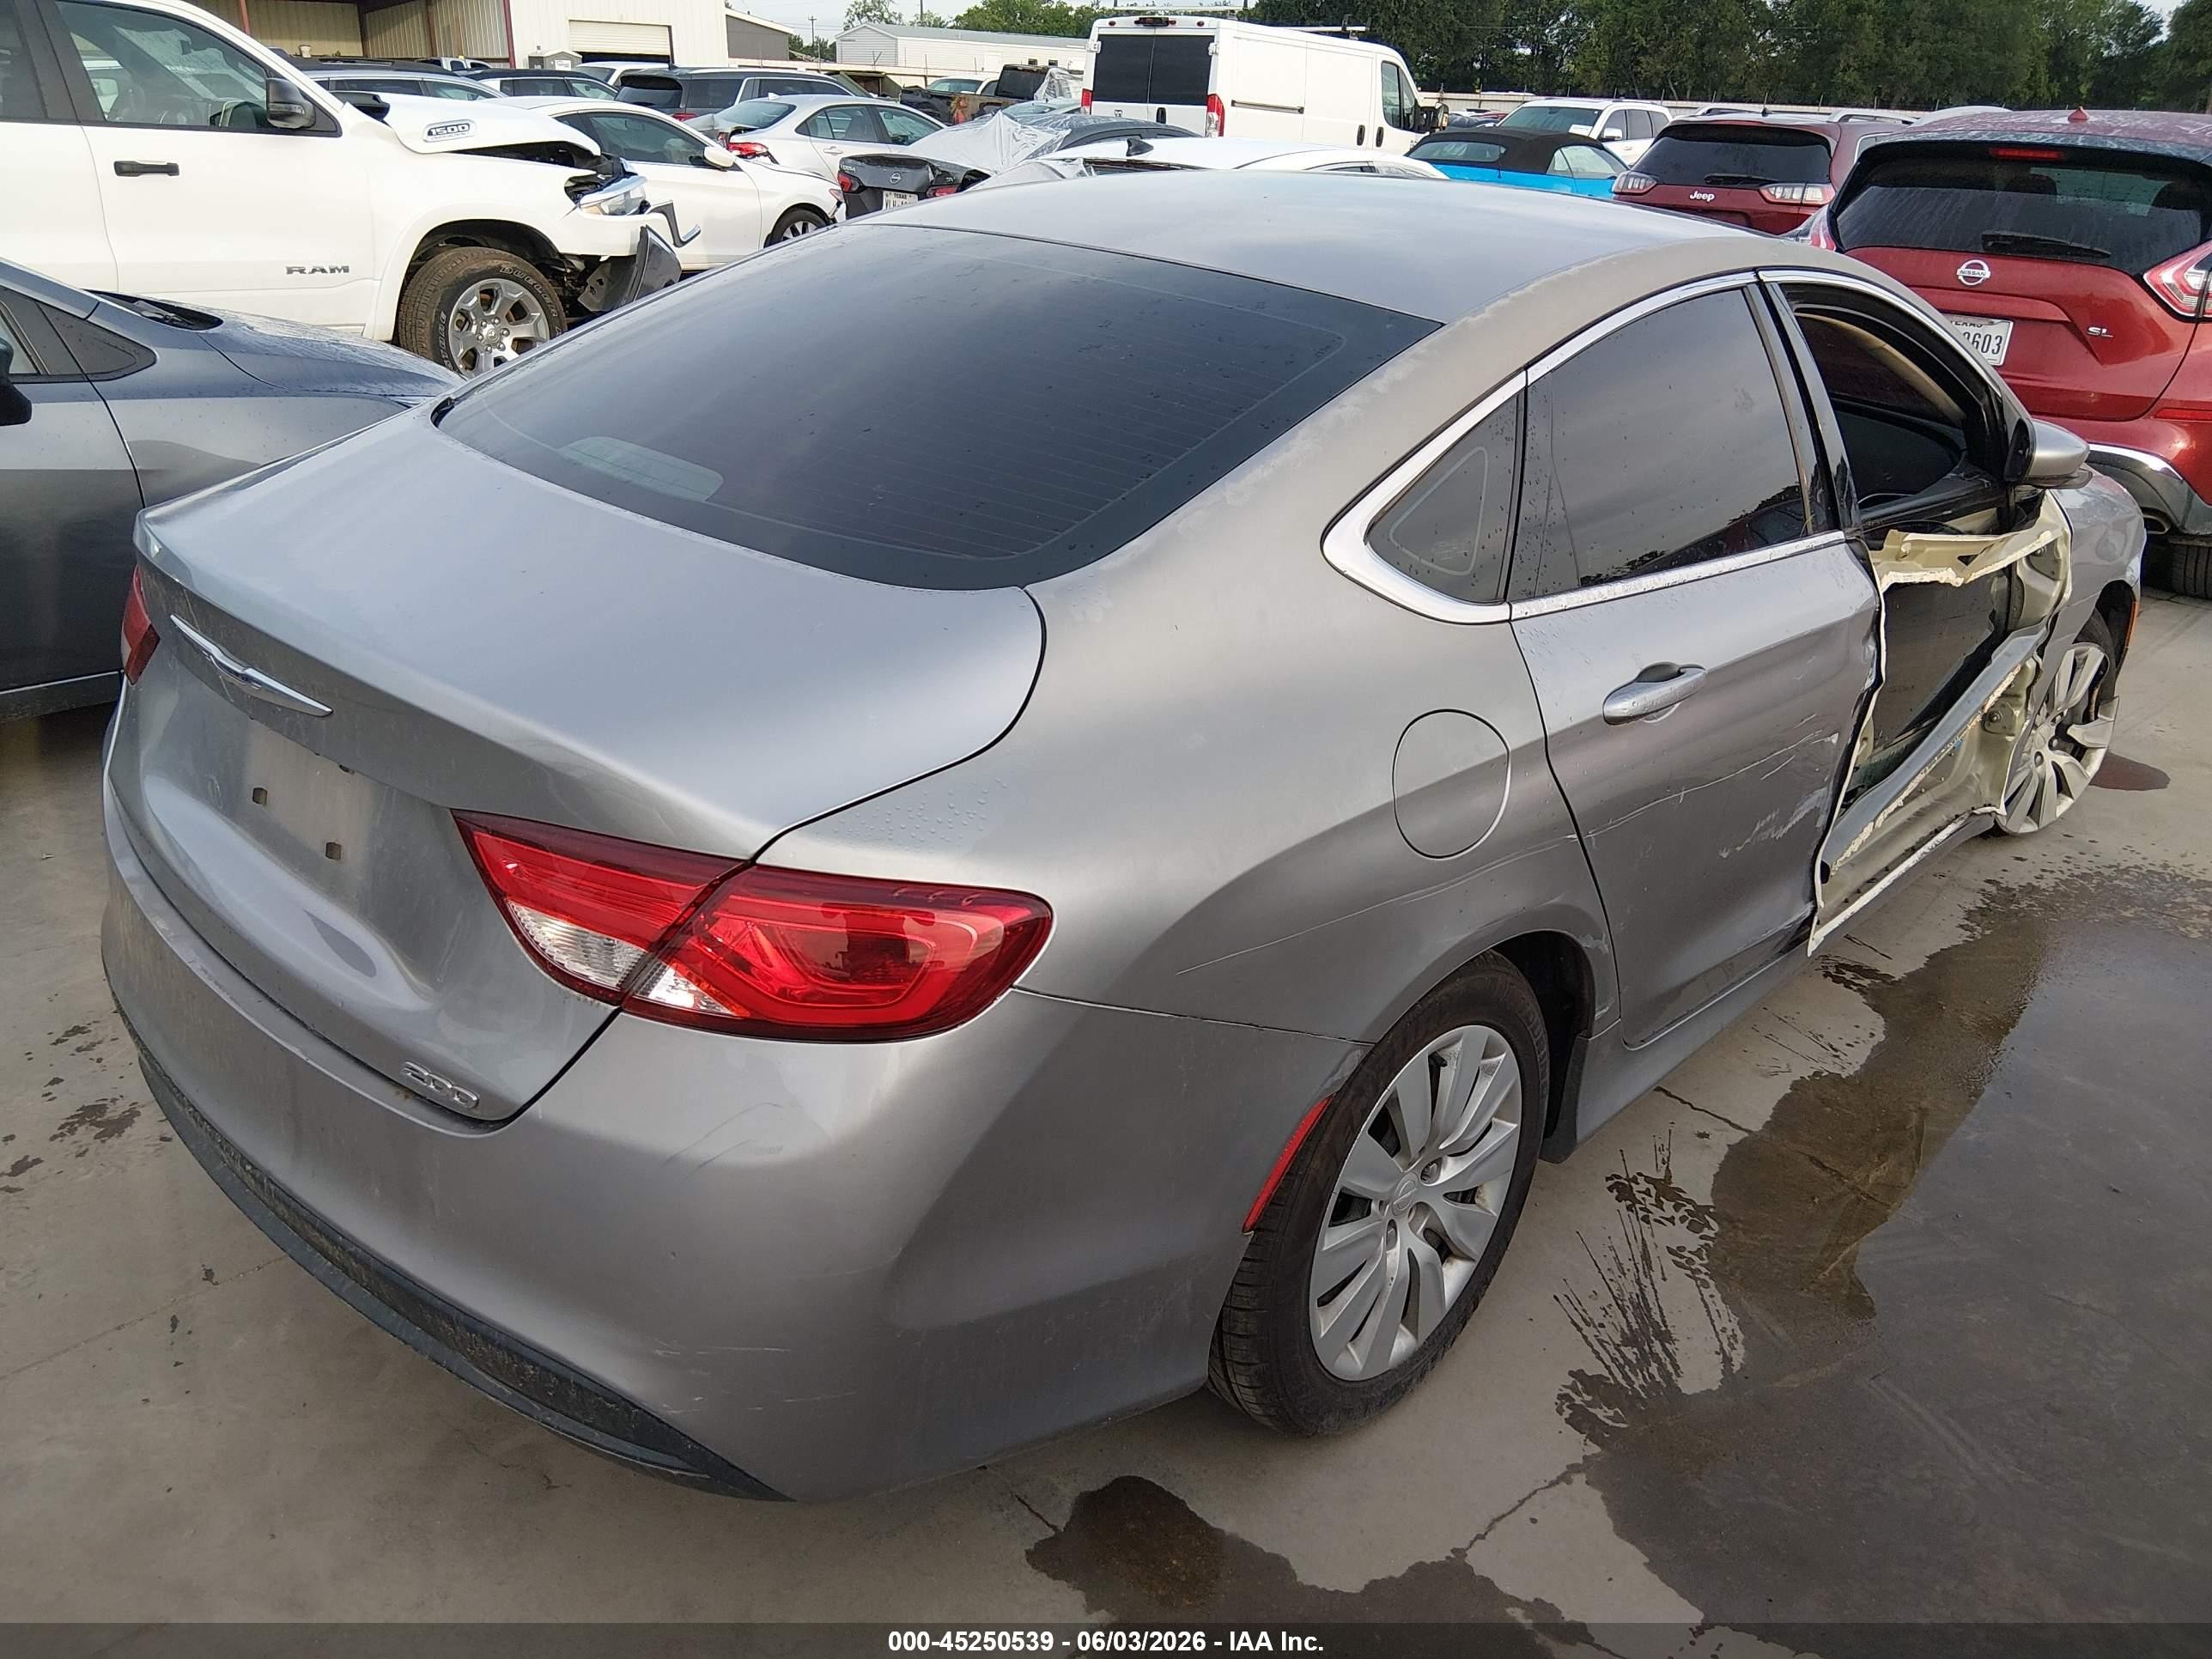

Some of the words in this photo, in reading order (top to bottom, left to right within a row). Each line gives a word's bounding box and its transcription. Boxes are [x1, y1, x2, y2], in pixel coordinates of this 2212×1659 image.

[429, 124, 470, 136] 1500
[1689, 191, 1715, 203] Jeep
[286, 265, 349, 275] RAM
[2087, 327, 2114, 337] SL
[400, 1060, 479, 1109] 200
